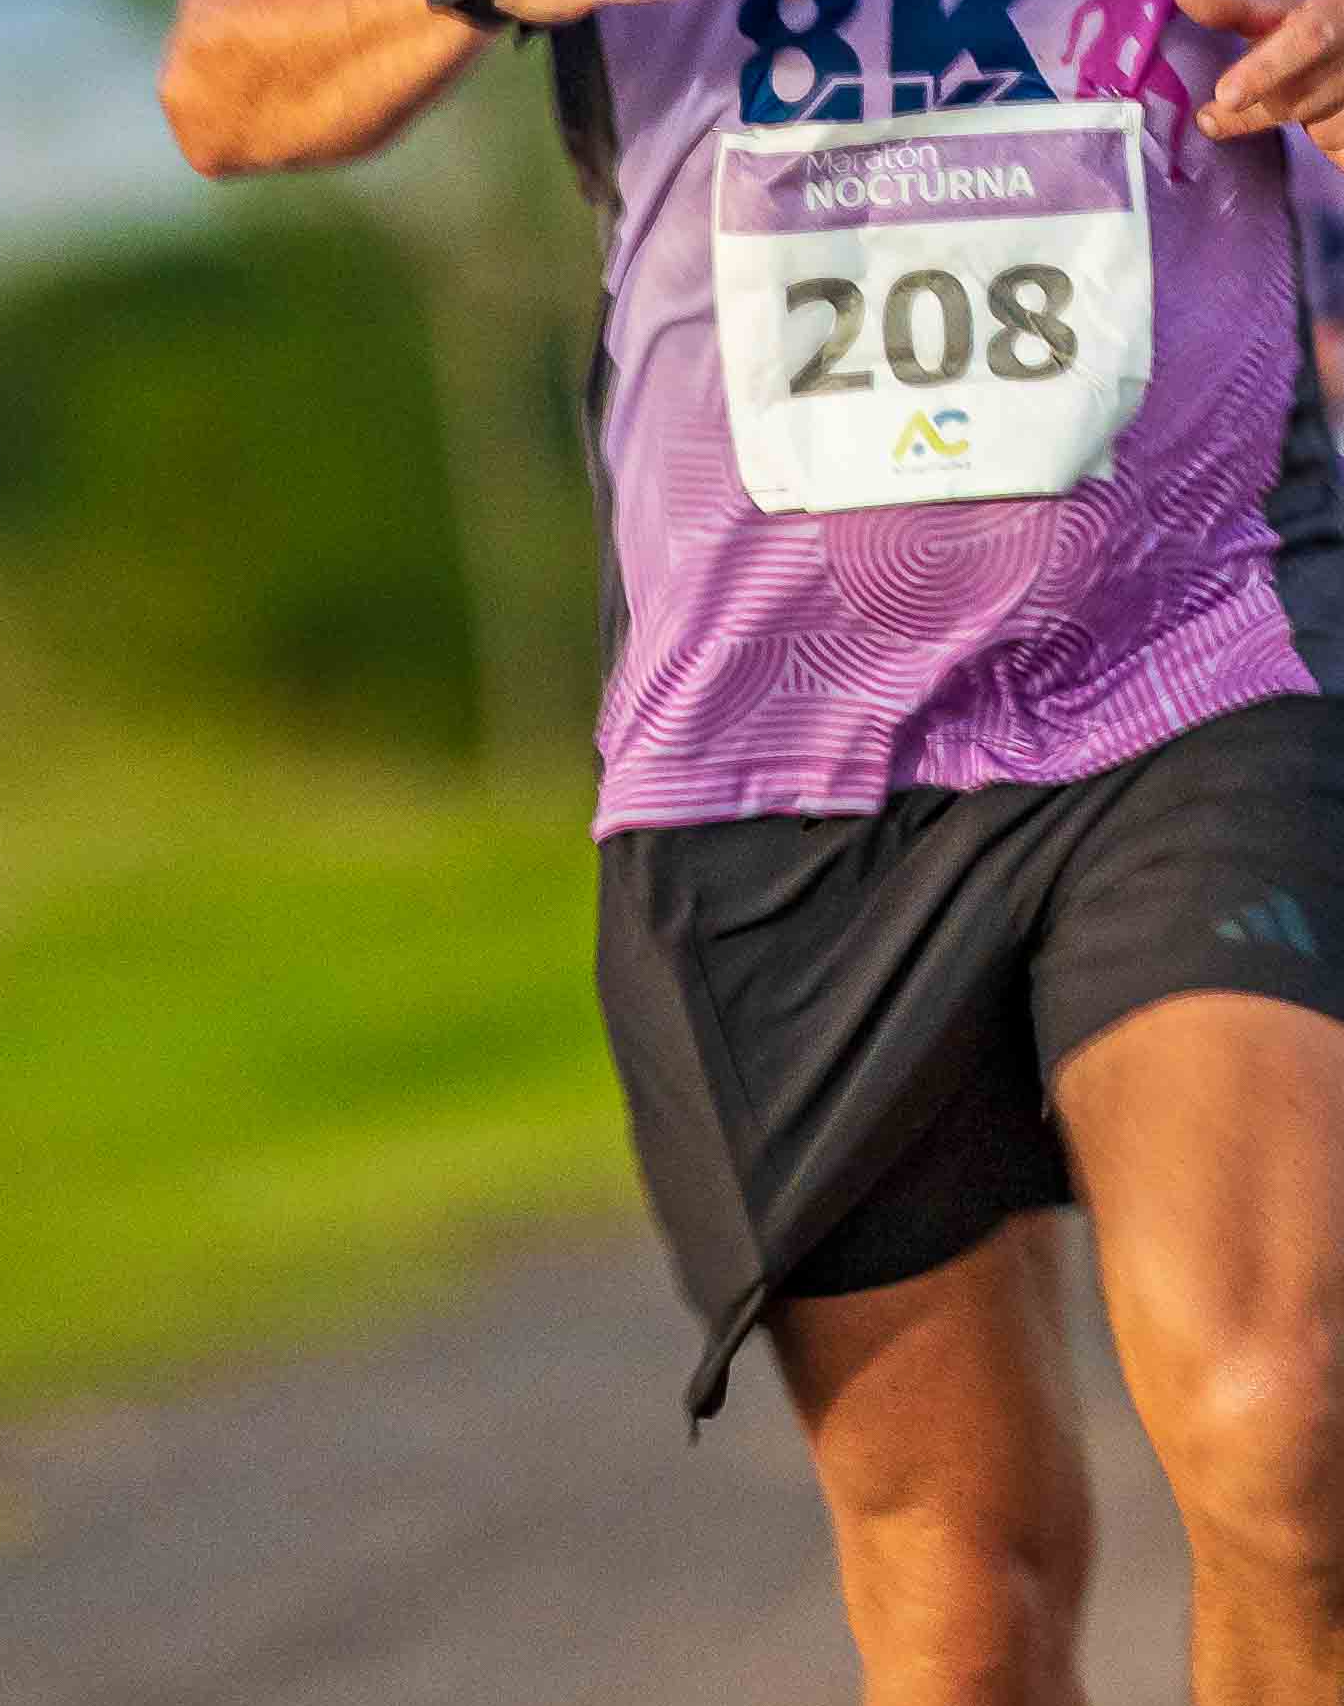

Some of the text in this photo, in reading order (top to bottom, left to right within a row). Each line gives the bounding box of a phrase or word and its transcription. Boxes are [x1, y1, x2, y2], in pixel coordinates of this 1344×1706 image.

[803, 140, 1037, 213] Maratón NOCTURNA
[785, 263, 1079, 398] 208
